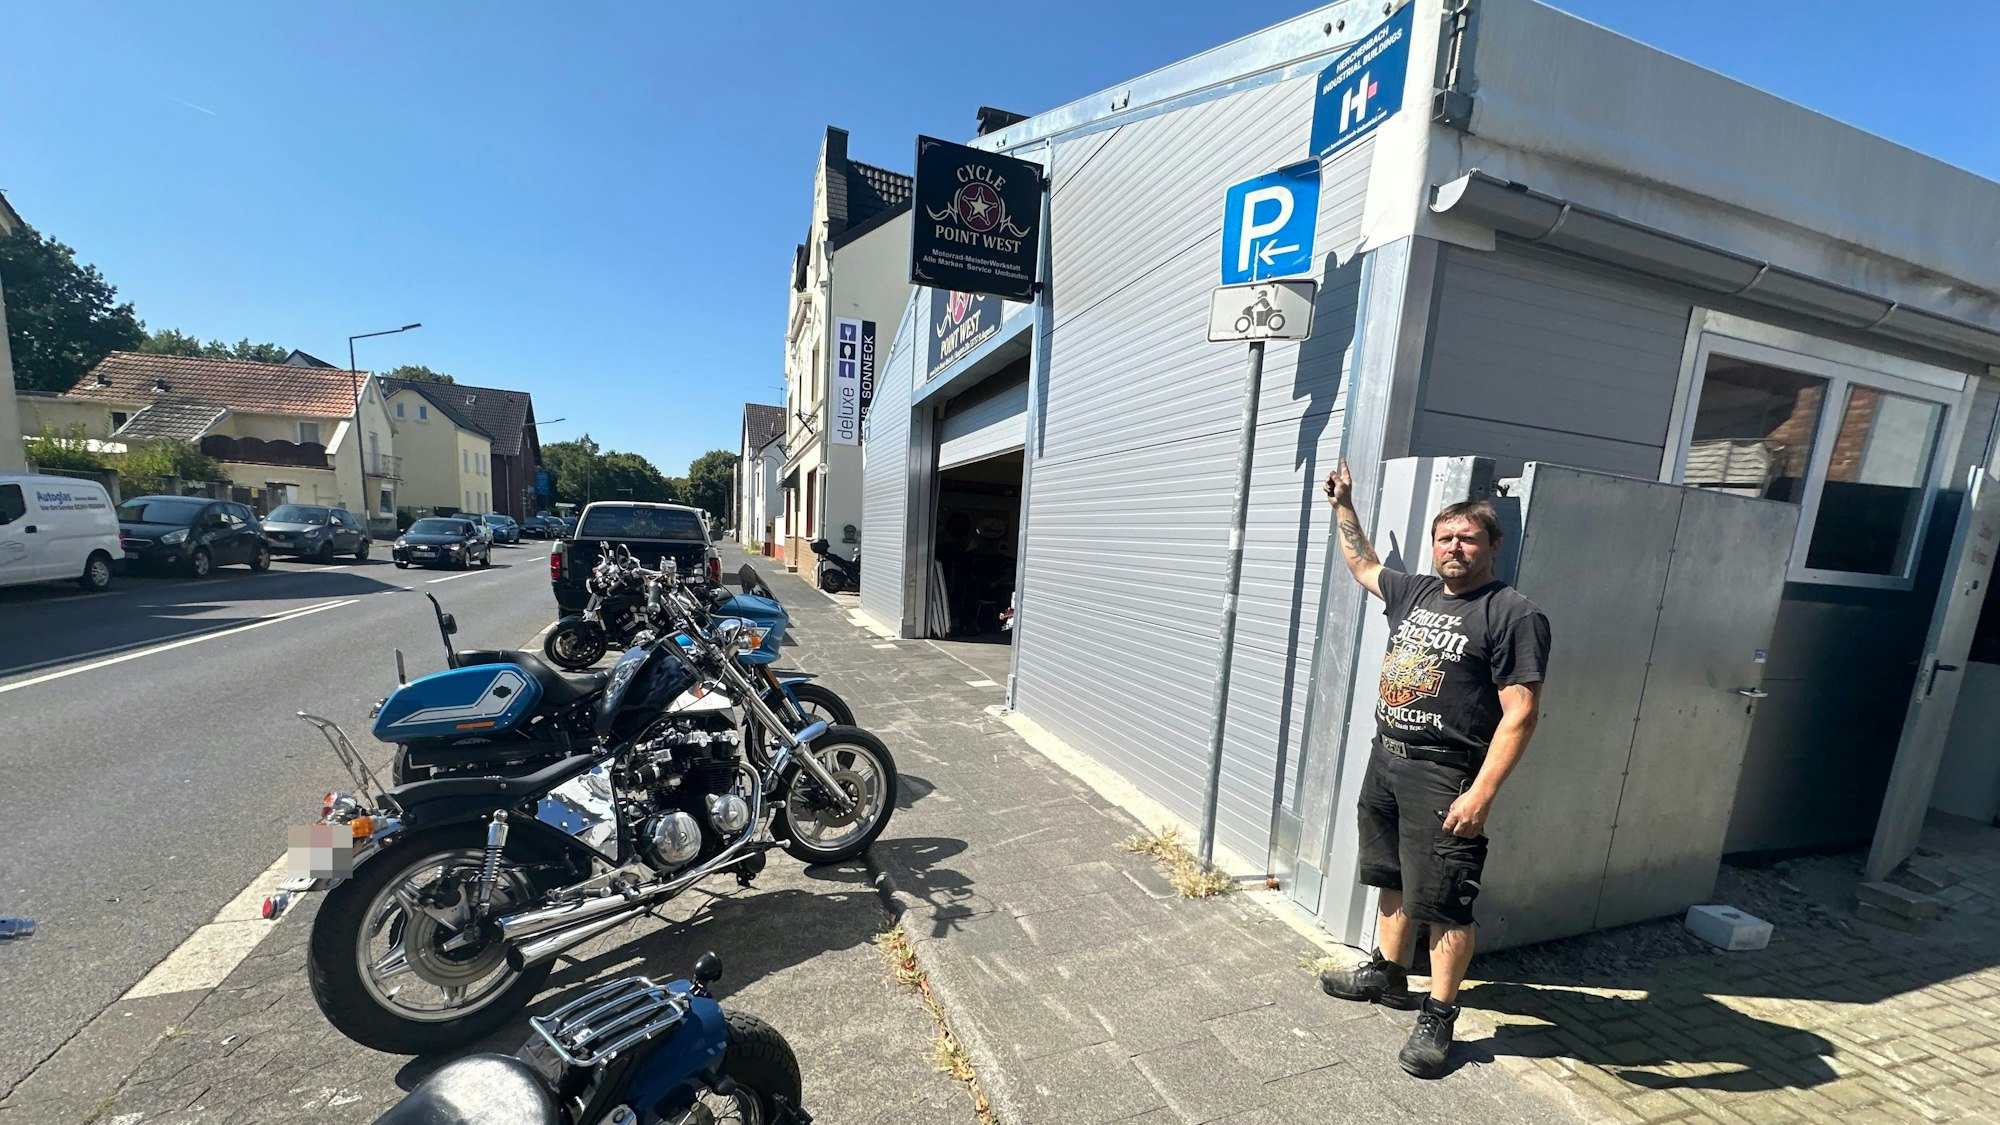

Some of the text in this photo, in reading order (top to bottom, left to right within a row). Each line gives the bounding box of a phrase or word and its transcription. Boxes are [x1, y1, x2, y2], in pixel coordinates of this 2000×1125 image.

[1322, 28, 1403, 95] INDUSTRIAL BUILDINGS
[1336, 25, 1389, 73] HERCHENBACH
[957, 164, 1007, 192] CYCLE
[935, 224, 1022, 254] POINT WEST
[1238, 185, 1295, 272] P
[923, 255, 1029, 281] Alle Marken Service Umbauten
[932, 248, 1021, 271] Motorrad-MeisterWerkstatt
[940, 327, 960, 360] POINT
[960, 310, 981, 344] WEST
[861, 335, 874, 399] SONNECK
[837, 387, 855, 440] deluxe
[36, 491, 72, 504] Autoglas
[633, 509, 653, 517] CYCLE
[1440, 651, 1461, 662] 1903
